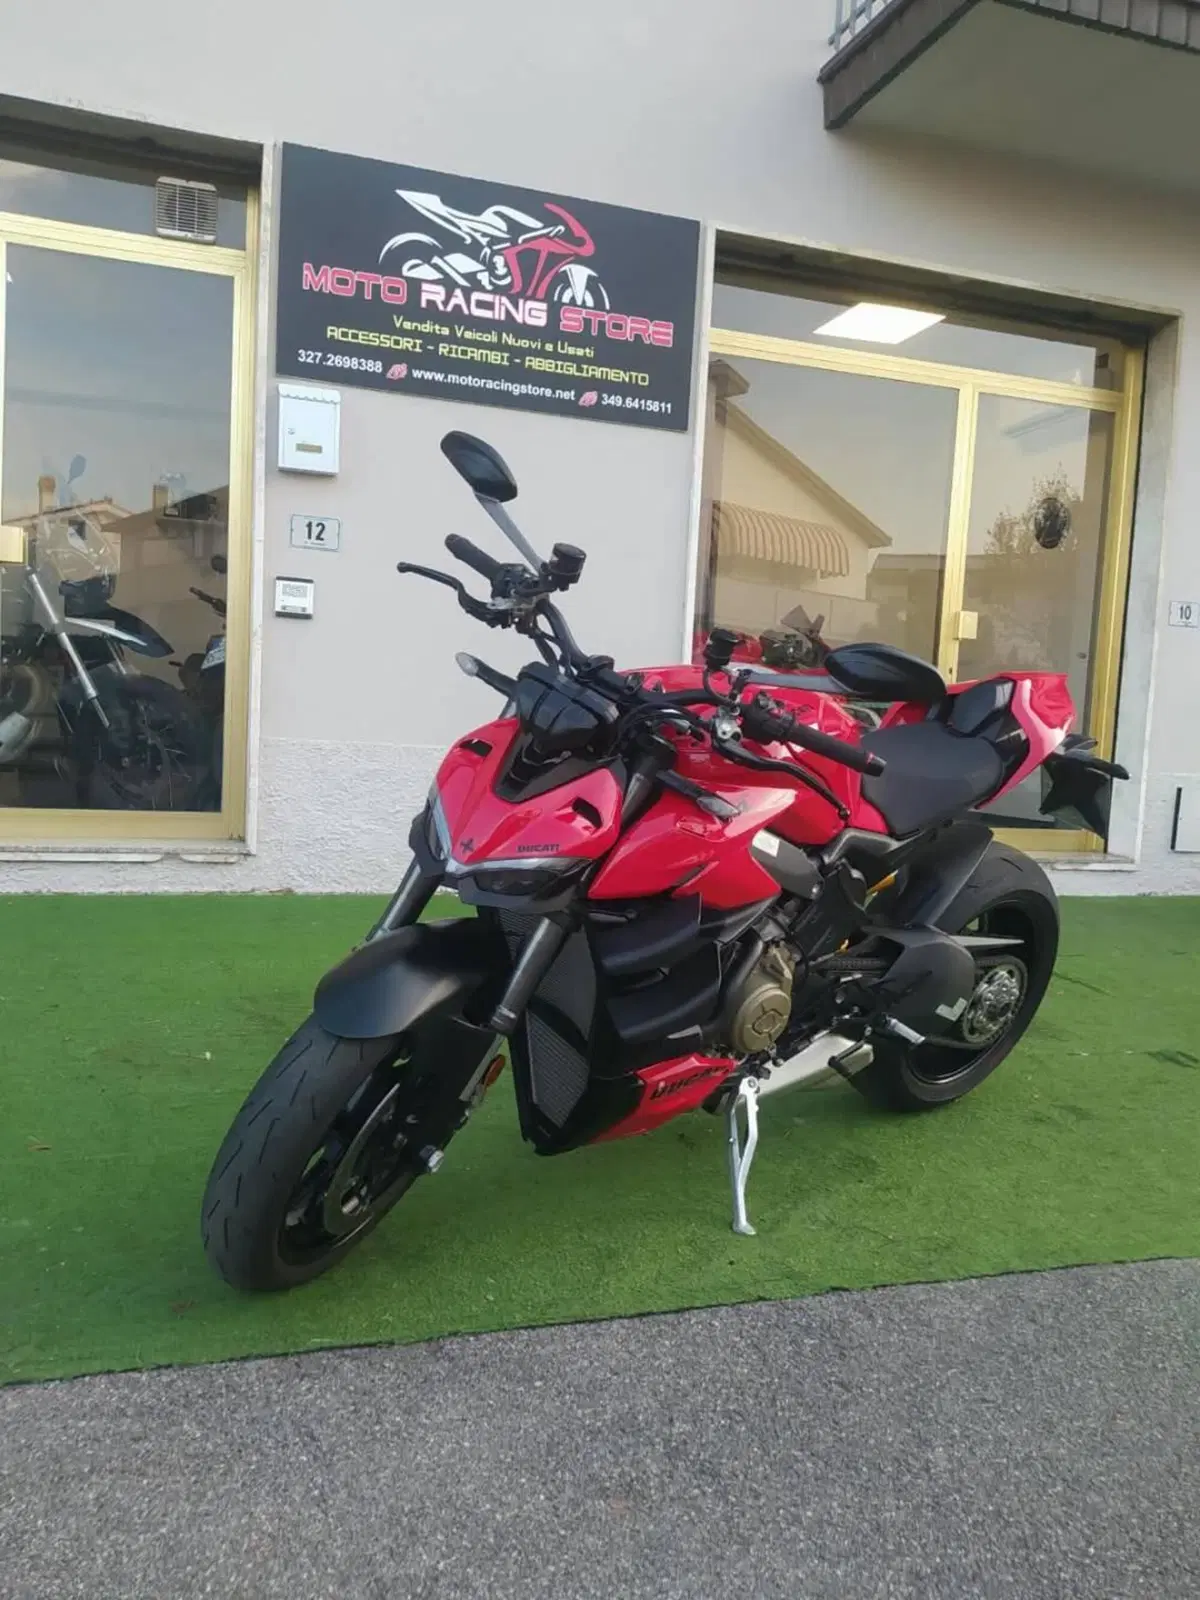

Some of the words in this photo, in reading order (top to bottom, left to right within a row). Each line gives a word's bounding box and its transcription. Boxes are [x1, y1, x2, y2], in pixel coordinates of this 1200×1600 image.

[303, 262, 407, 304] MOTO
[420, 281, 548, 327] RACING
[559, 305, 674, 348] STORE
[327, 326, 422, 352] ACCESSORI
[438, 342, 510, 366] RICAMBI
[525, 355, 650, 386] ABBIGLIAMENTO
[393, 315, 449, 335] Vendita
[454, 324, 498, 344] Veicoli
[501, 332, 541, 350] Nuovi
[544, 341, 554, 352] e
[557, 340, 595, 358] Usati
[298, 350, 382, 373] 327.2698388
[411, 368, 576, 401] www.motoracingstore.net
[601, 393, 672, 414] 349.6415811
[305, 520, 326, 541] 12
[1179, 605, 1192, 620] 10
